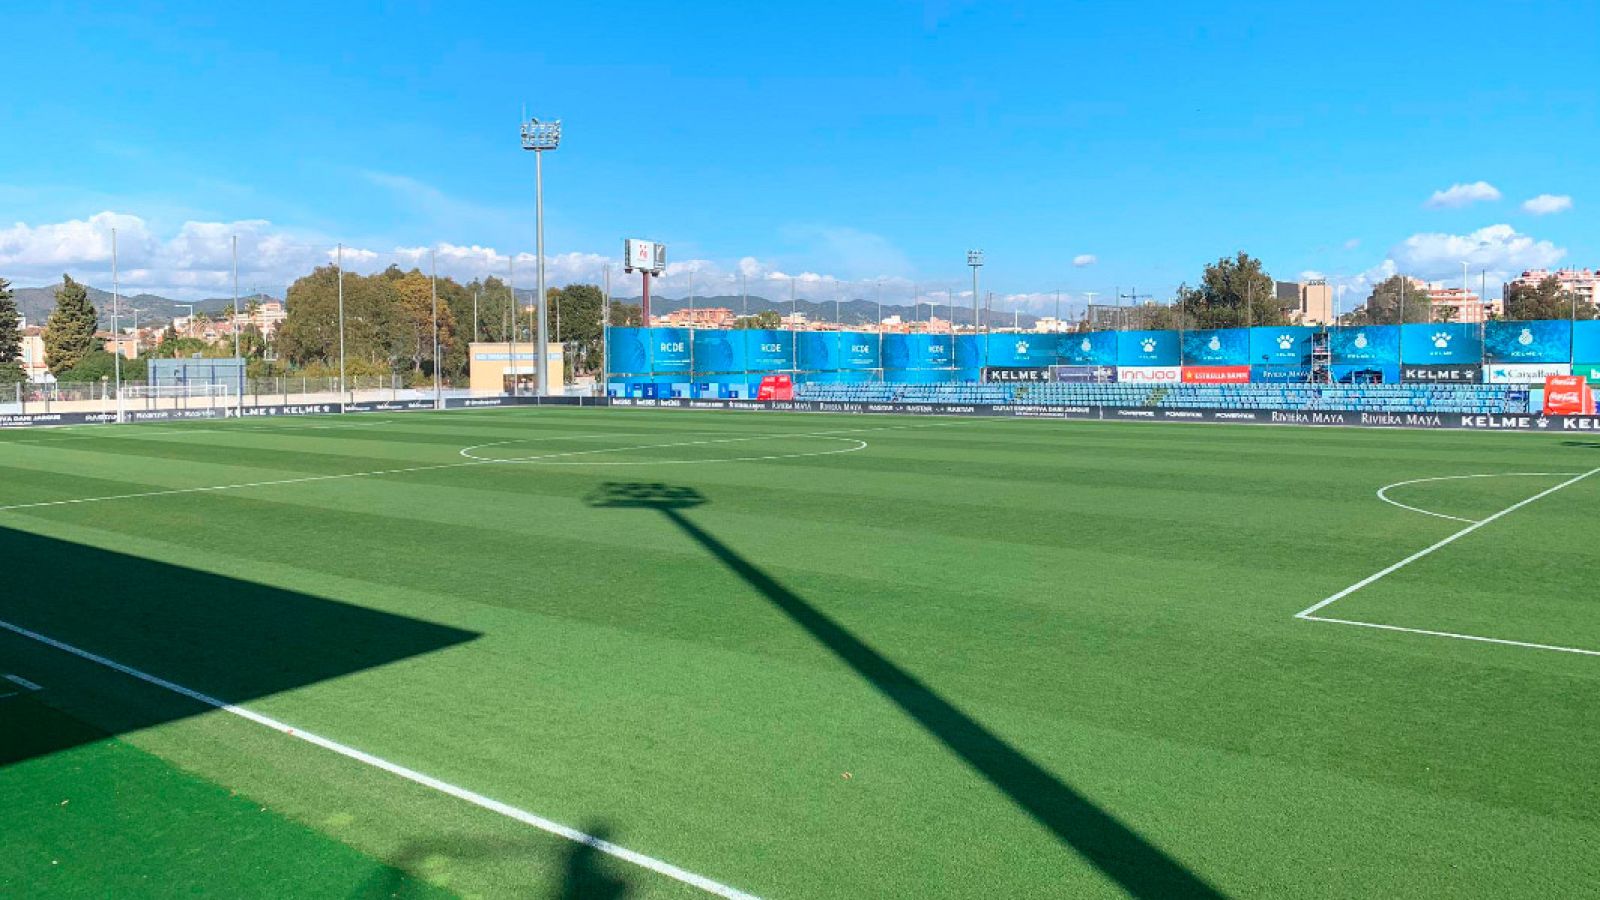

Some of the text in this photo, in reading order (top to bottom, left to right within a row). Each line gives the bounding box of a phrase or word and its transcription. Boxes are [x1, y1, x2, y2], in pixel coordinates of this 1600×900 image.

[661, 342, 684, 352] RCDE
[761, 344, 781, 353] RCDE
[992, 370, 1038, 379] KELME
[1406, 369, 1460, 379] KELME
[283, 406, 320, 414] KELME
[1271, 411, 1344, 423] RIVIERA MAYA
[1361, 412, 1441, 426] RIVIERA MAYA
[1462, 416, 1530, 428] KELME
